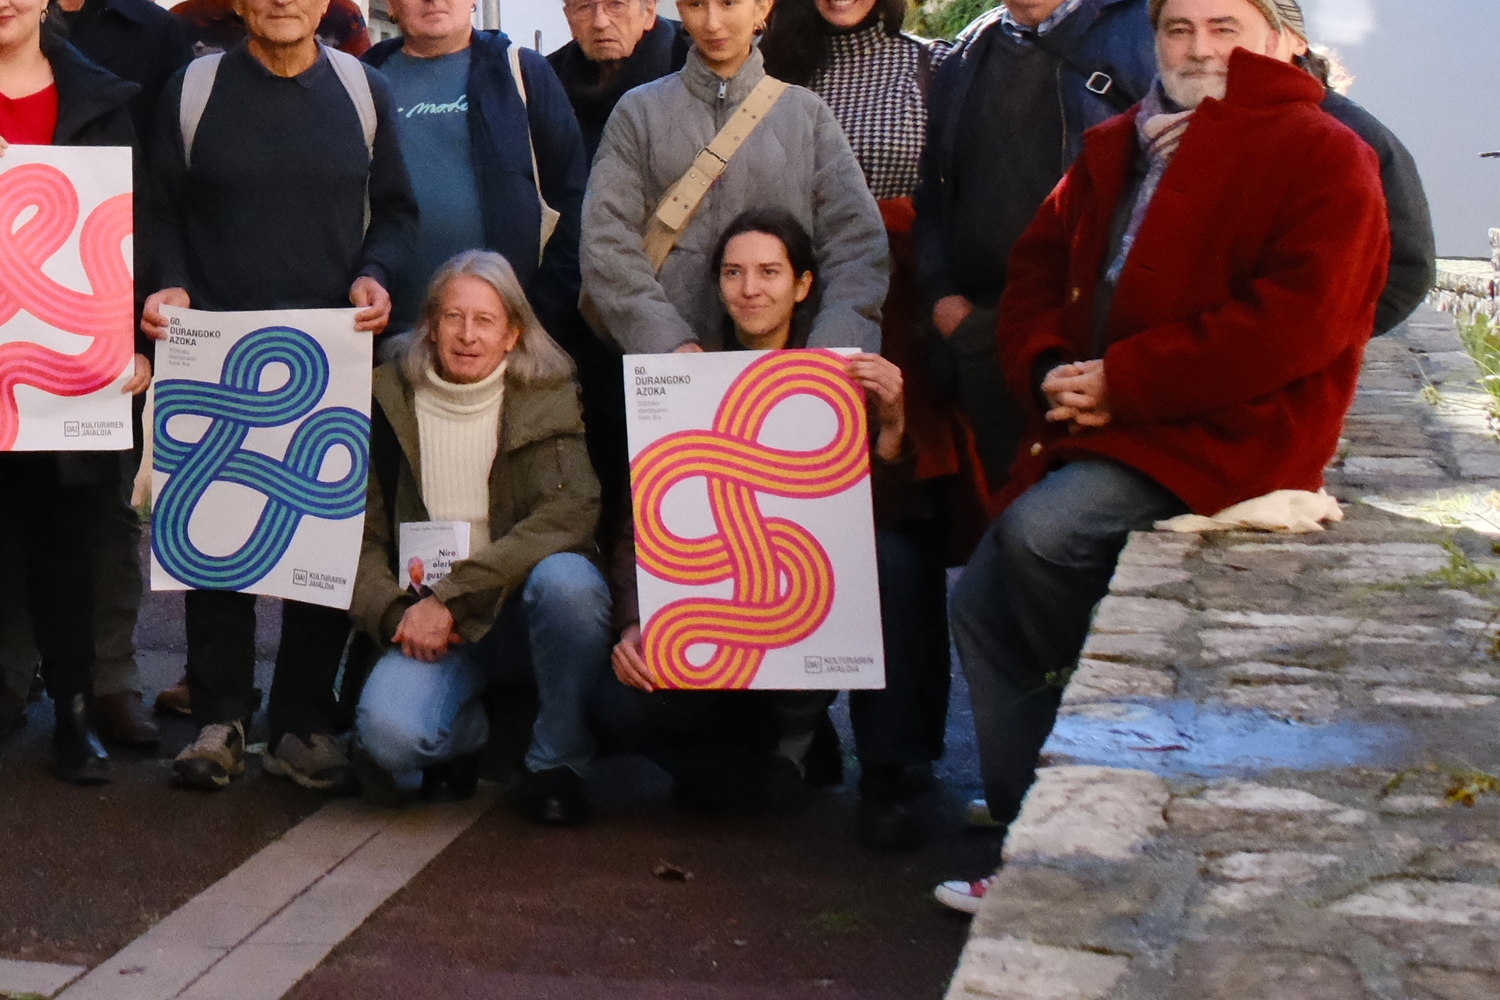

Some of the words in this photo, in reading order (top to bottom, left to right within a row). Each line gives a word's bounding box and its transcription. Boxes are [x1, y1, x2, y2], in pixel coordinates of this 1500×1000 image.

[169, 326, 221, 338] DURANGOKO
[169, 336, 197, 346] AZOKA
[635, 374, 691, 386] DURANGOKO
[636, 386, 666, 396] AZOKA
